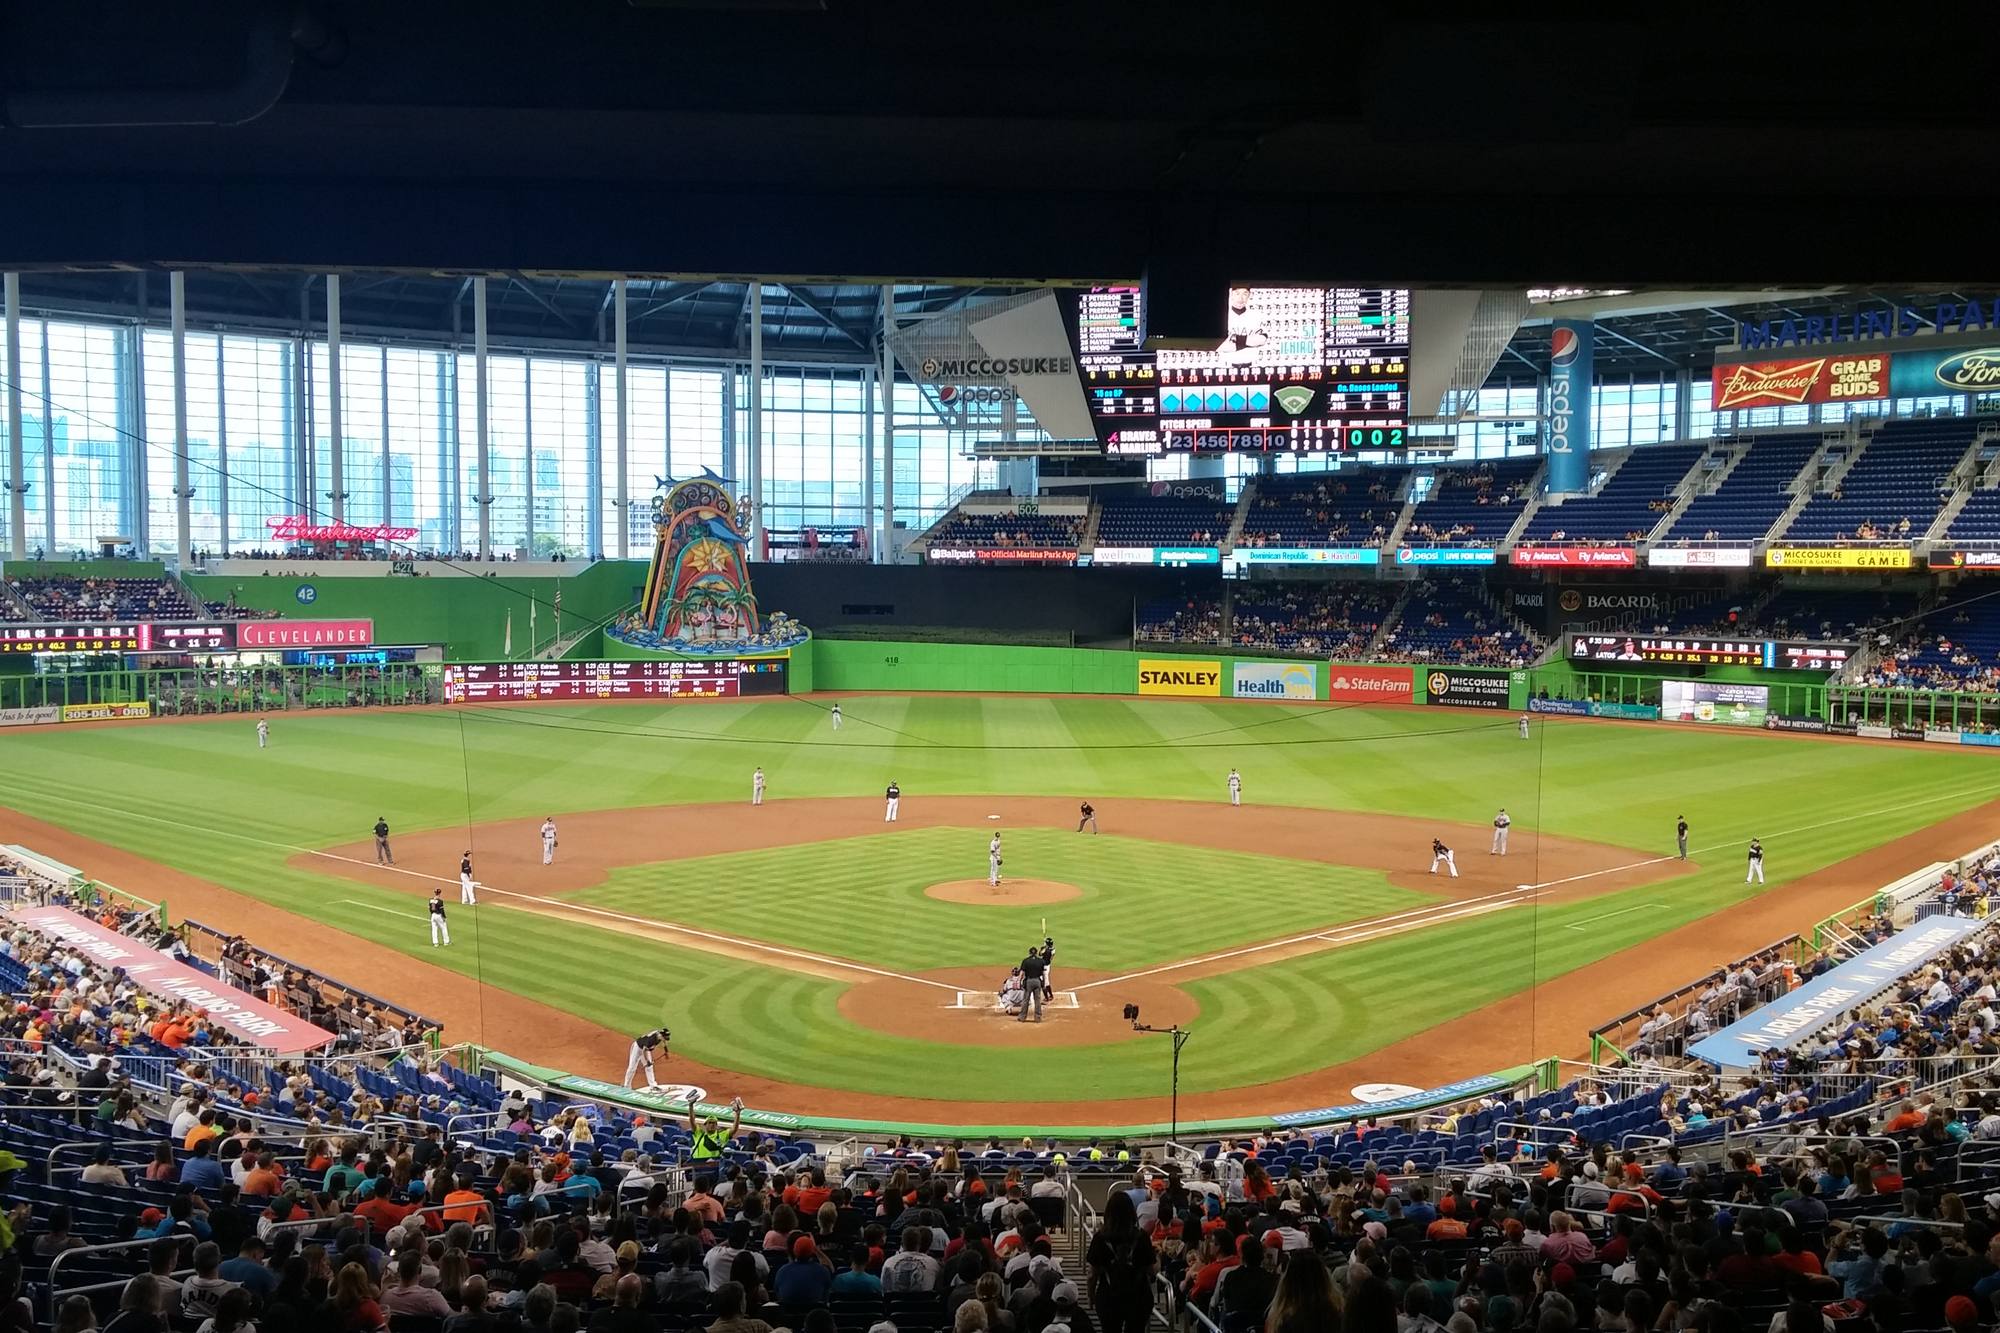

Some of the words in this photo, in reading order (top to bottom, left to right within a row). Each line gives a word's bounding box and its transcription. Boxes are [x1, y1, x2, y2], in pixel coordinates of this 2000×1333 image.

[1740, 306, 1919, 351] MARLINS
[1281, 341, 1313, 354] ICHIRO
[1326, 350, 1338, 358] 35
[1340, 349, 1371, 357] LATOS
[942, 356, 1071, 375] MICCOSUKEE
[1093, 356, 1122, 364] WOOD
[1331, 366, 1337, 375] 2
[1350, 365, 1360, 374] 13
[1830, 359, 1881, 376] GRAB
[1108, 370, 1116, 379] 11
[1125, 370, 1133, 379] 17
[1839, 372, 1872, 383] SOME
[1722, 373, 1818, 395] Budweiser
[1830, 381, 1880, 397] BUDS
[962, 385, 1017, 406] pepsi
[1978, 399, 2000, 411] 448
[1551, 370, 1573, 453] pepsi
[1160, 420, 1185, 429] PITCH
[1186, 419, 1212, 428] SPEED
[1120, 431, 1156, 441] BRAVES
[1333, 428, 1338, 438] 1
[1351, 430, 1362, 446] 0
[1371, 430, 1383, 446] 0
[1390, 429, 1402, 445] 2
[1518, 435, 1537, 445] 465
[1120, 443, 1162, 453] MARLINS
[1303, 440, 1309, 450] 2
[1019, 505, 1038, 514] 502
[941, 549, 975, 559] Ballpark
[977, 550, 990, 558] The
[991, 550, 1016, 558] Official
[1017, 550, 1043, 558] Marlins
[1044, 550, 1061, 558] Park
[1062, 551, 1077, 560] App
[1282, 552, 1308, 560] Republic
[1414, 552, 1438, 560] pepsi
[1520, 551, 1530, 562] Fly
[1579, 551, 1590, 562] Fly
[1784, 551, 1842, 559] MICCOSUKEE
[1858, 557, 1905, 566] GAME!
[395, 563, 412, 572] 427
[298, 589, 314, 598] 42
[1588, 593, 1656, 608] BACARDÍ
[16, 629, 30, 638] ERA
[35, 629, 46, 638] GS
[128, 627, 135, 636] K
[243, 626, 367, 645] CLEVELANDER
[169, 640, 176, 648] 6
[188, 639, 200, 648] 11
[208, 638, 220, 647] 17
[426, 665, 441, 674] 386
[749, 664, 756, 672] K
[1792, 659, 1798, 667] 2
[1810, 660, 1822, 668] 13
[1830, 661, 1842, 669] 15
[1141, 671, 1216, 686] STANLEY
[1513, 672, 1526, 680] 392
[1451, 677, 1509, 688] MICCOSUKEE
[1439, 698, 1497, 706] MICCOSUKEE.COM
[1541, 700, 1573, 709] Preferred
[1, 710, 15, 721] has
[17, 710, 23, 719] to
[26, 709, 33, 719] be
[1792, 721, 1823, 729] NETWORK
[1734, 1003, 1826, 1048] MARLINS
[1451, 1076, 1498, 1091] RICOH
[1402, 1087, 1449, 1103] RICOH
[1339, 1099, 1400, 1114] RICOH
[1272, 1109, 1336, 1124] RICOH
